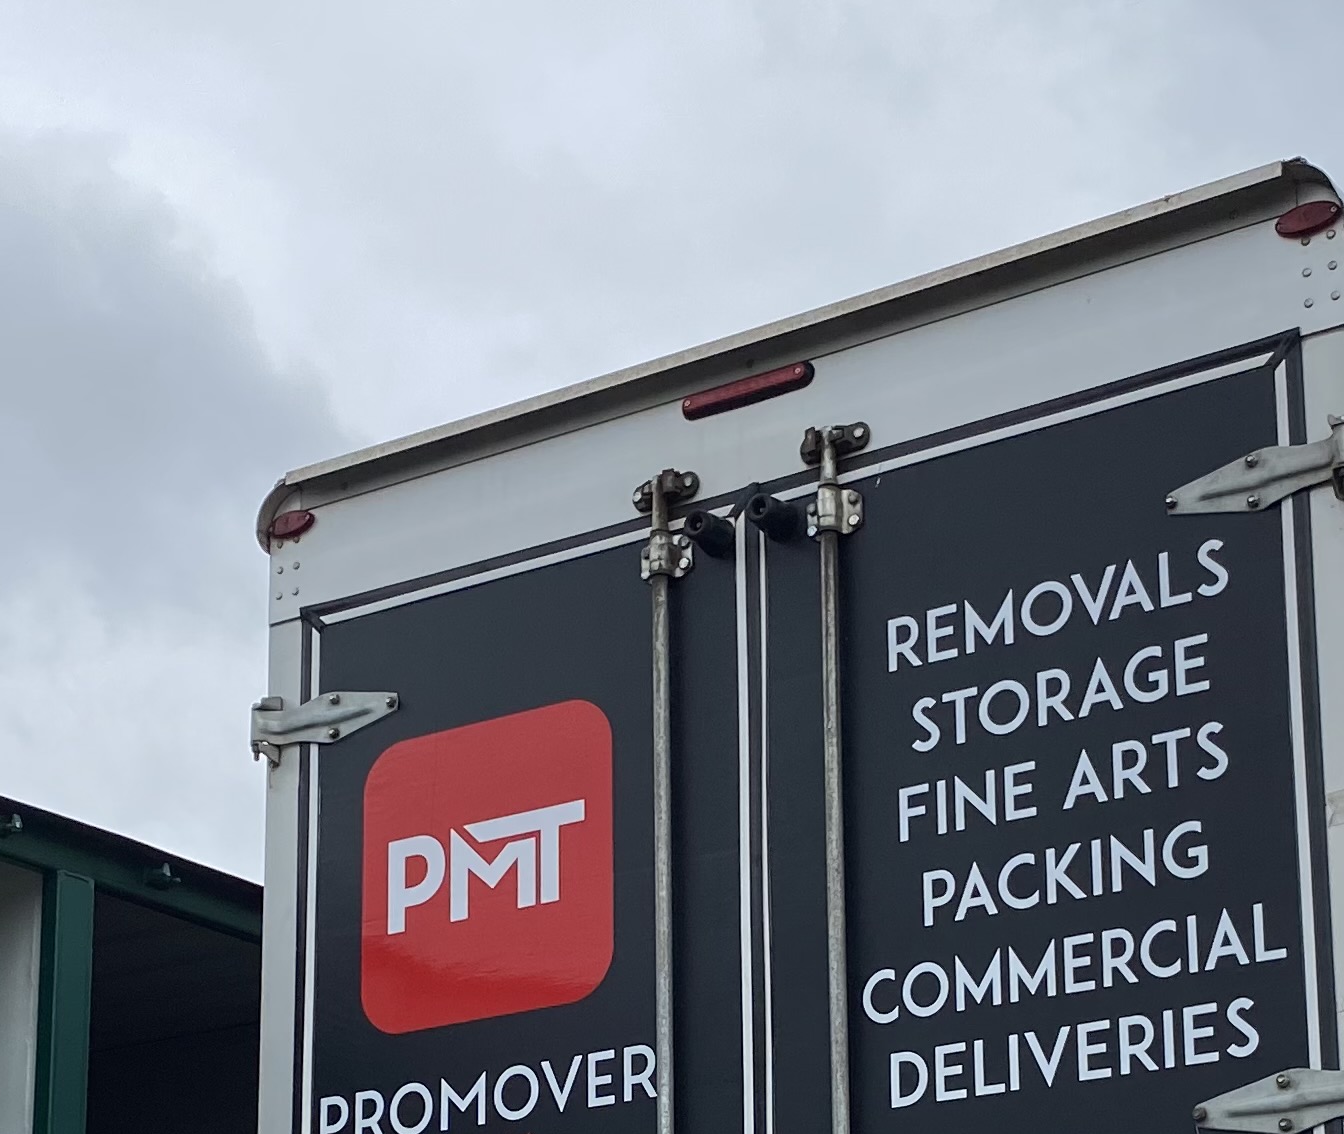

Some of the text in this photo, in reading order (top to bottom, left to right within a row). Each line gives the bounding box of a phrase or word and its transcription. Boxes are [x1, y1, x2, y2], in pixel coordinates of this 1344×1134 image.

[887, 539, 1229, 673] REMOVALS
[911, 632, 1210, 752] STORAGE
[898, 721, 1229, 843] FINE ARTS
[387, 798, 586, 935] PMT
[922, 820, 1209, 927] PACKING
[862, 902, 1287, 1024] COMMERCIAL
[890, 997, 1260, 1109] DELIVERIES
